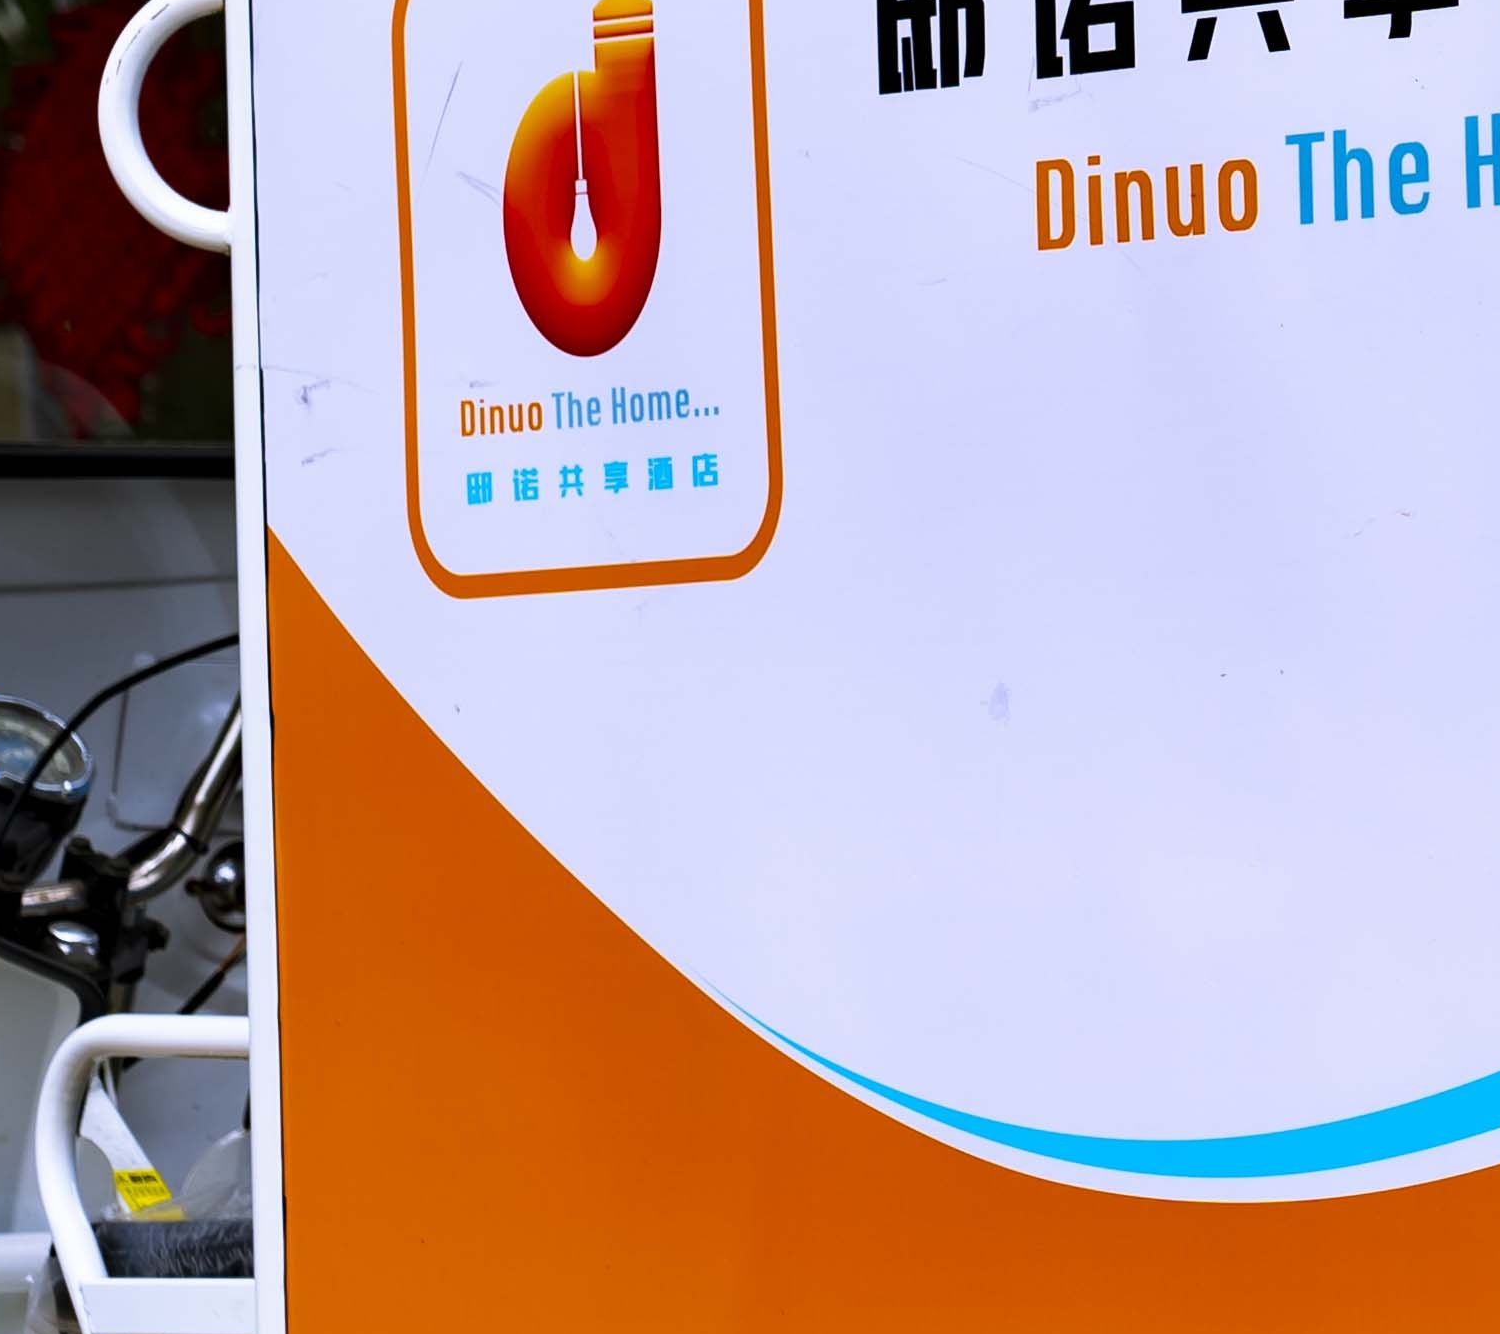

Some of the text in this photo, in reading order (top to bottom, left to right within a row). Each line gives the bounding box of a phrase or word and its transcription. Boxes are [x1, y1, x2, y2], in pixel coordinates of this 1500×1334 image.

[1035, 154, 1260, 252] Dinuo
[1284, 128, 1431, 227] The
[459, 386, 720, 437] Dinuo The Home...
[465, 451, 720, 507] 邸诺共享酒店
